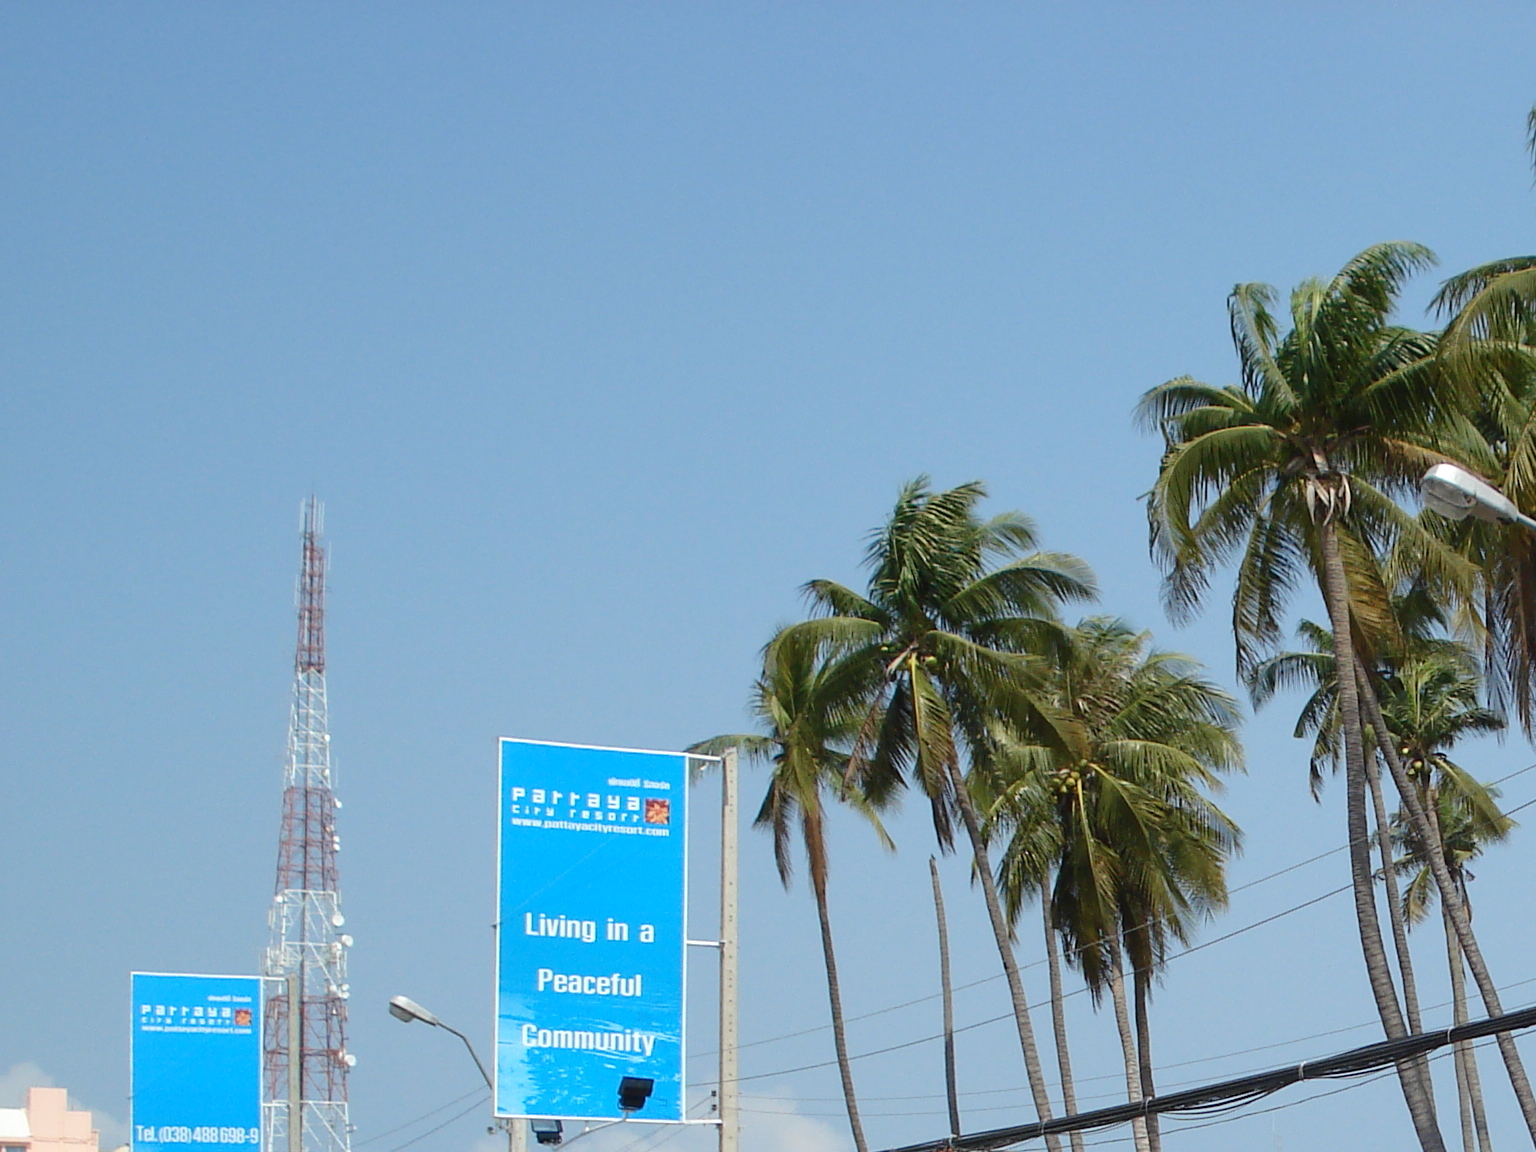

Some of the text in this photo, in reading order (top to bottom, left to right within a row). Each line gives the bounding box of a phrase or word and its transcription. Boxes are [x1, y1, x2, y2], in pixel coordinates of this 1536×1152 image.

[511, 817, 670, 837] www.pattayacityresort.com
[524, 912, 655, 943] Living in a
[537, 968, 642, 997] Peaceful
[521, 1023, 656, 1056] Community
[136, 1124, 259, 1144] Tel. (038) 488 698-9
